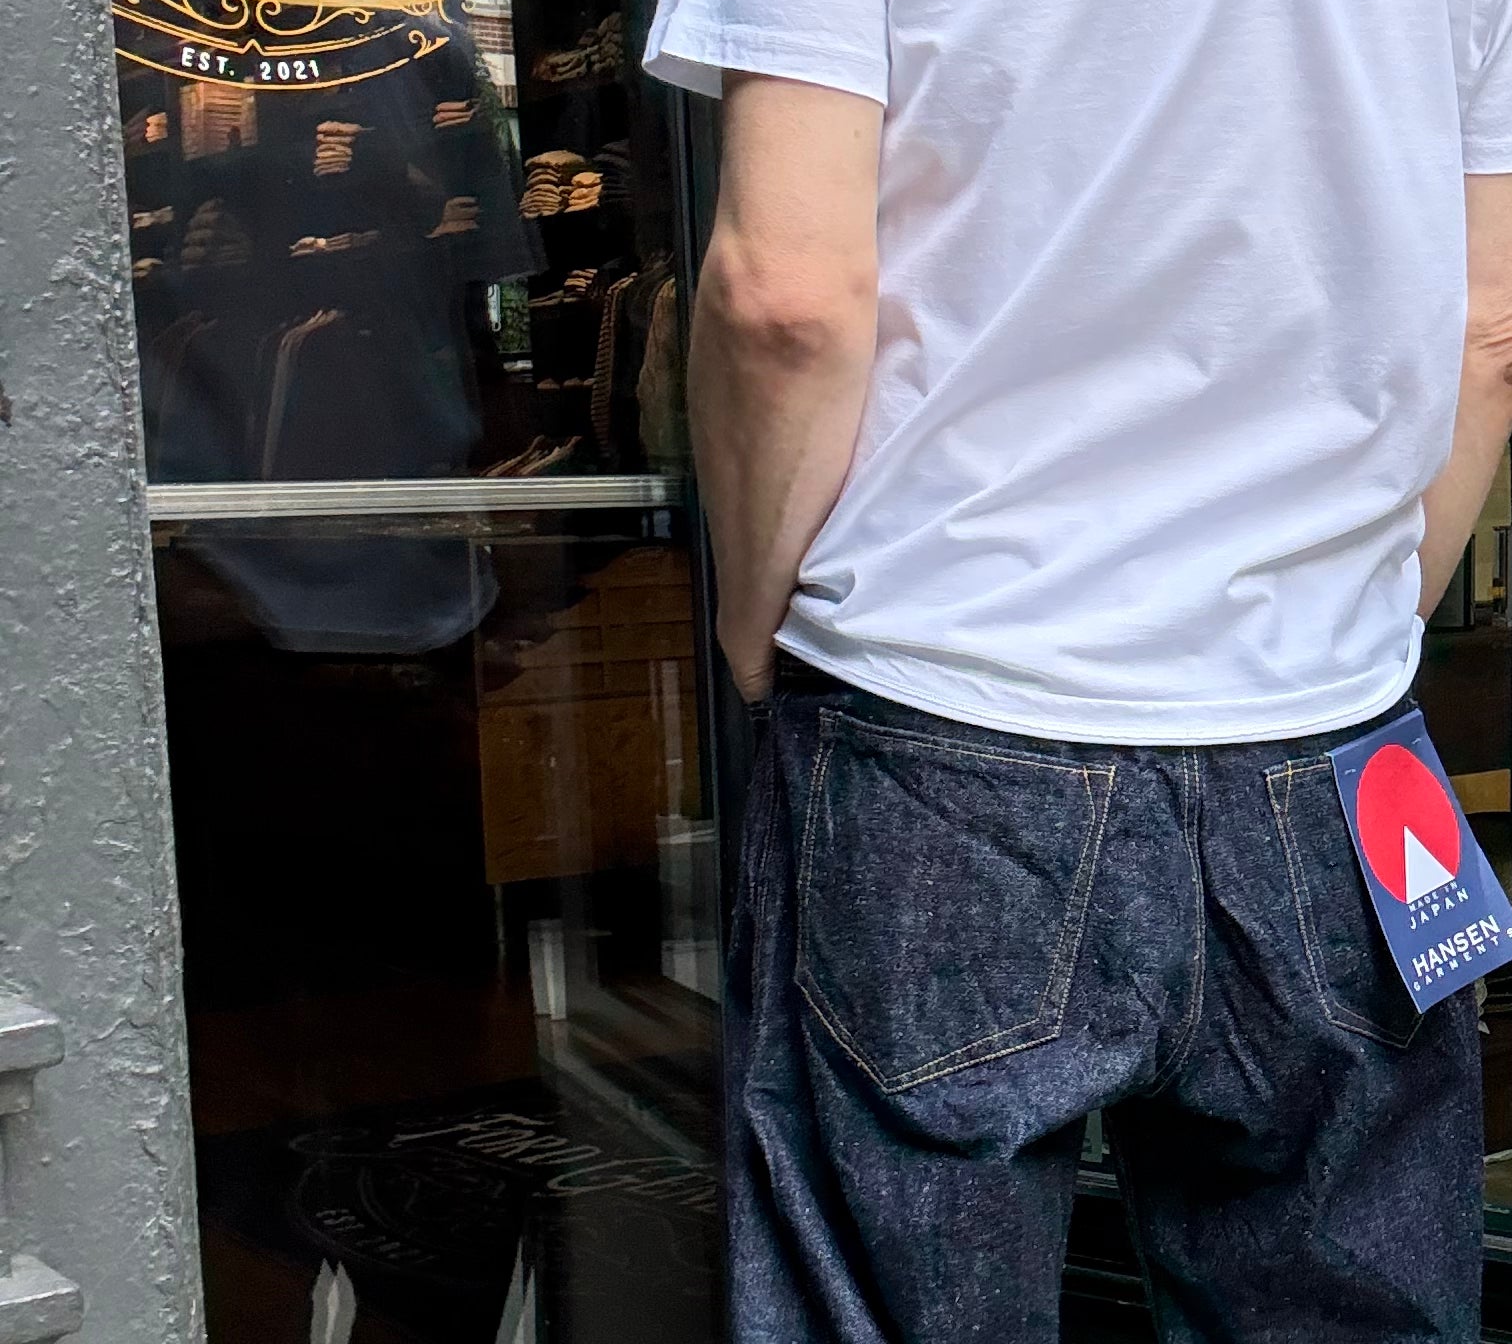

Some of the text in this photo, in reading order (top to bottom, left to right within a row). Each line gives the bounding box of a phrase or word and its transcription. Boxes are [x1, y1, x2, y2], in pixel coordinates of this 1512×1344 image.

[180, 46, 322, 82] EST. 2021
[1409, 891, 1440, 911] MADE
[1410, 888, 1469, 929] JAPAN
[1412, 915, 1501, 977] HANSEN
